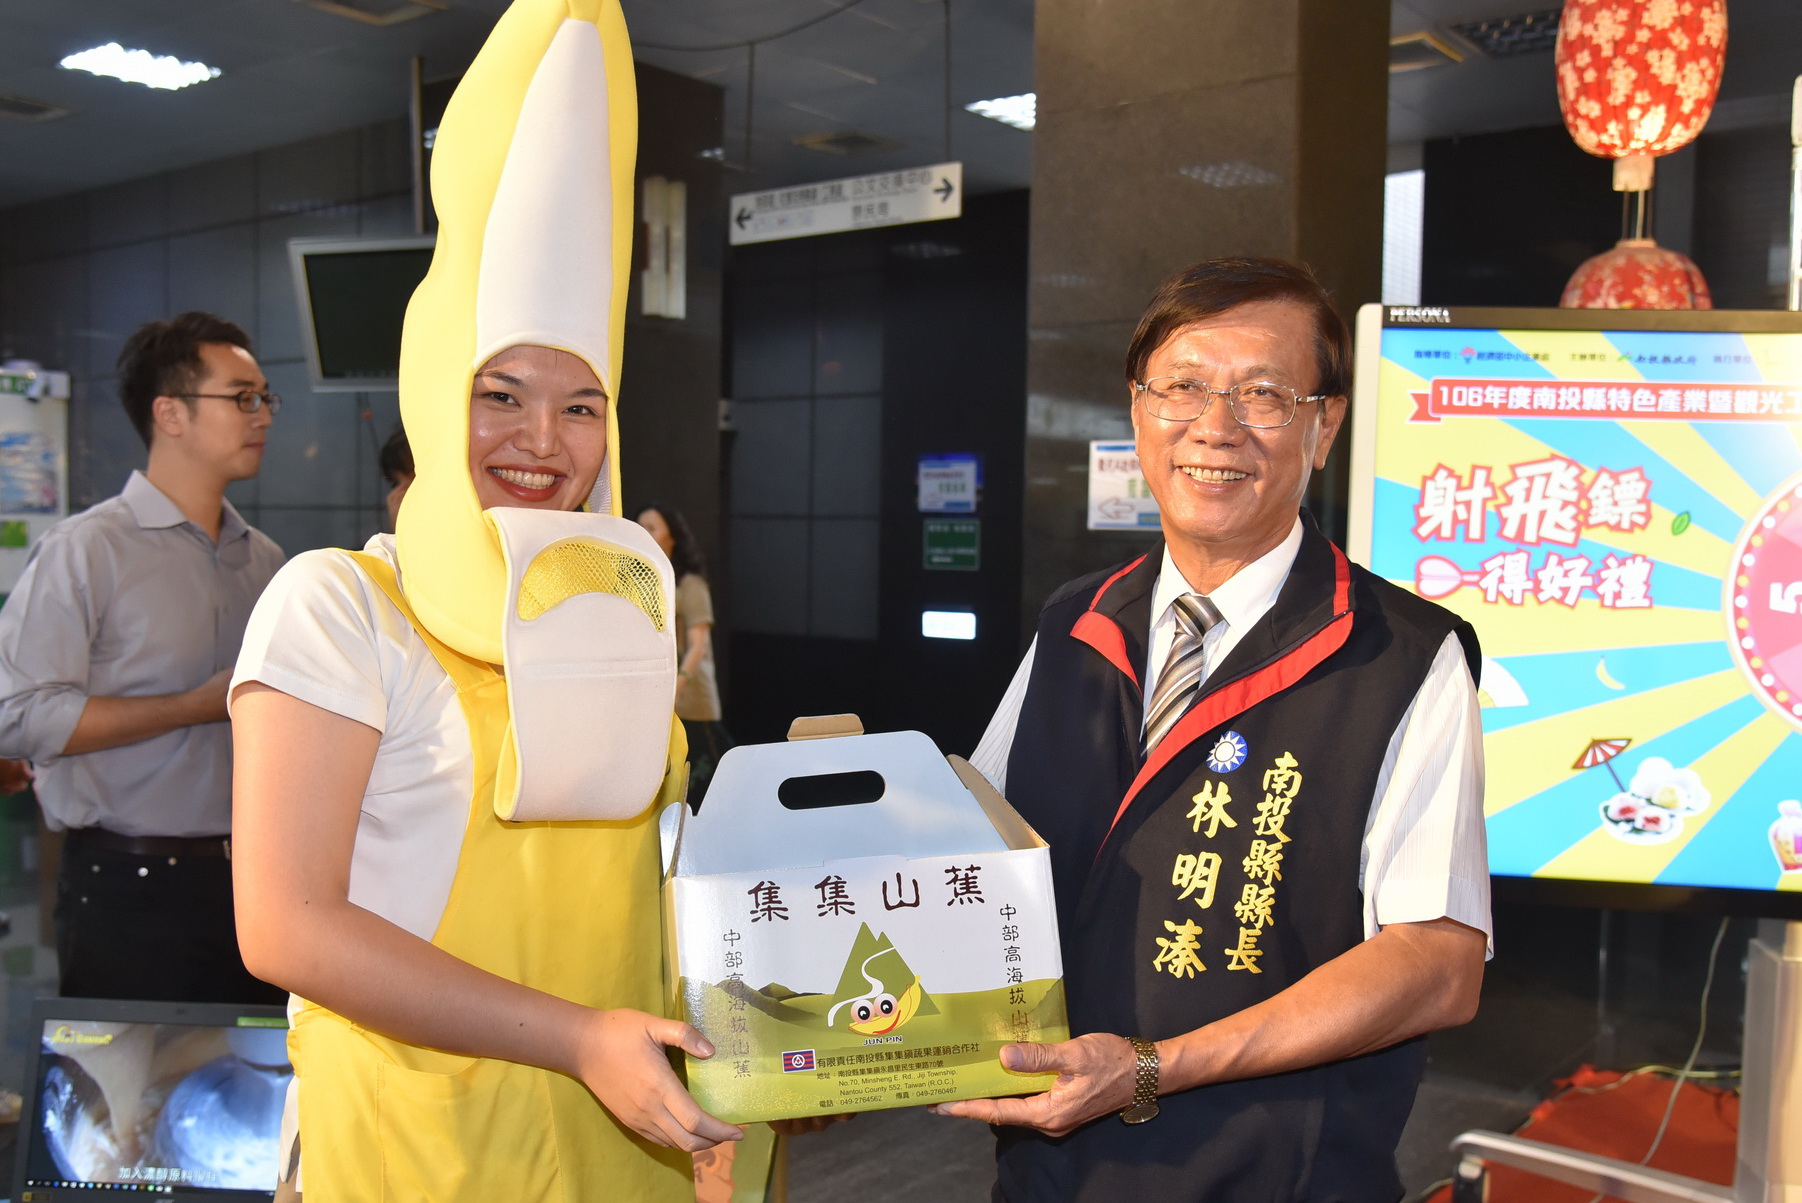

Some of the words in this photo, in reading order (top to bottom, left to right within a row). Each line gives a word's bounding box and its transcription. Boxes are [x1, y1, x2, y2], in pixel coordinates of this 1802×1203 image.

[1390, 306, 1451, 323] PERSONA
[1413, 455, 1650, 546] 射飛鏢
[1478, 549, 1654, 608] 得好禮
[1153, 779, 1238, 979] 林明溱
[1224, 751, 1302, 974] 南投縣縣長
[747, 864, 985, 923] 集集山蕉
[723, 929, 751, 1078] 中部高海拔山蕉
[817, 1042, 980, 1068] 有限責任南投縣集集鎮蔬果運銷合作社
[863, 1037, 883, 1045] JUN
[886, 1035, 902, 1043] PIN
[840, 1088, 863, 1096] Nantou
[864, 1086, 887, 1094] County
[888, 1083, 902, 1091] 552,
[904, 1081, 927, 1089] Taiwan
[861, 1075, 892, 1084] Minsheng
